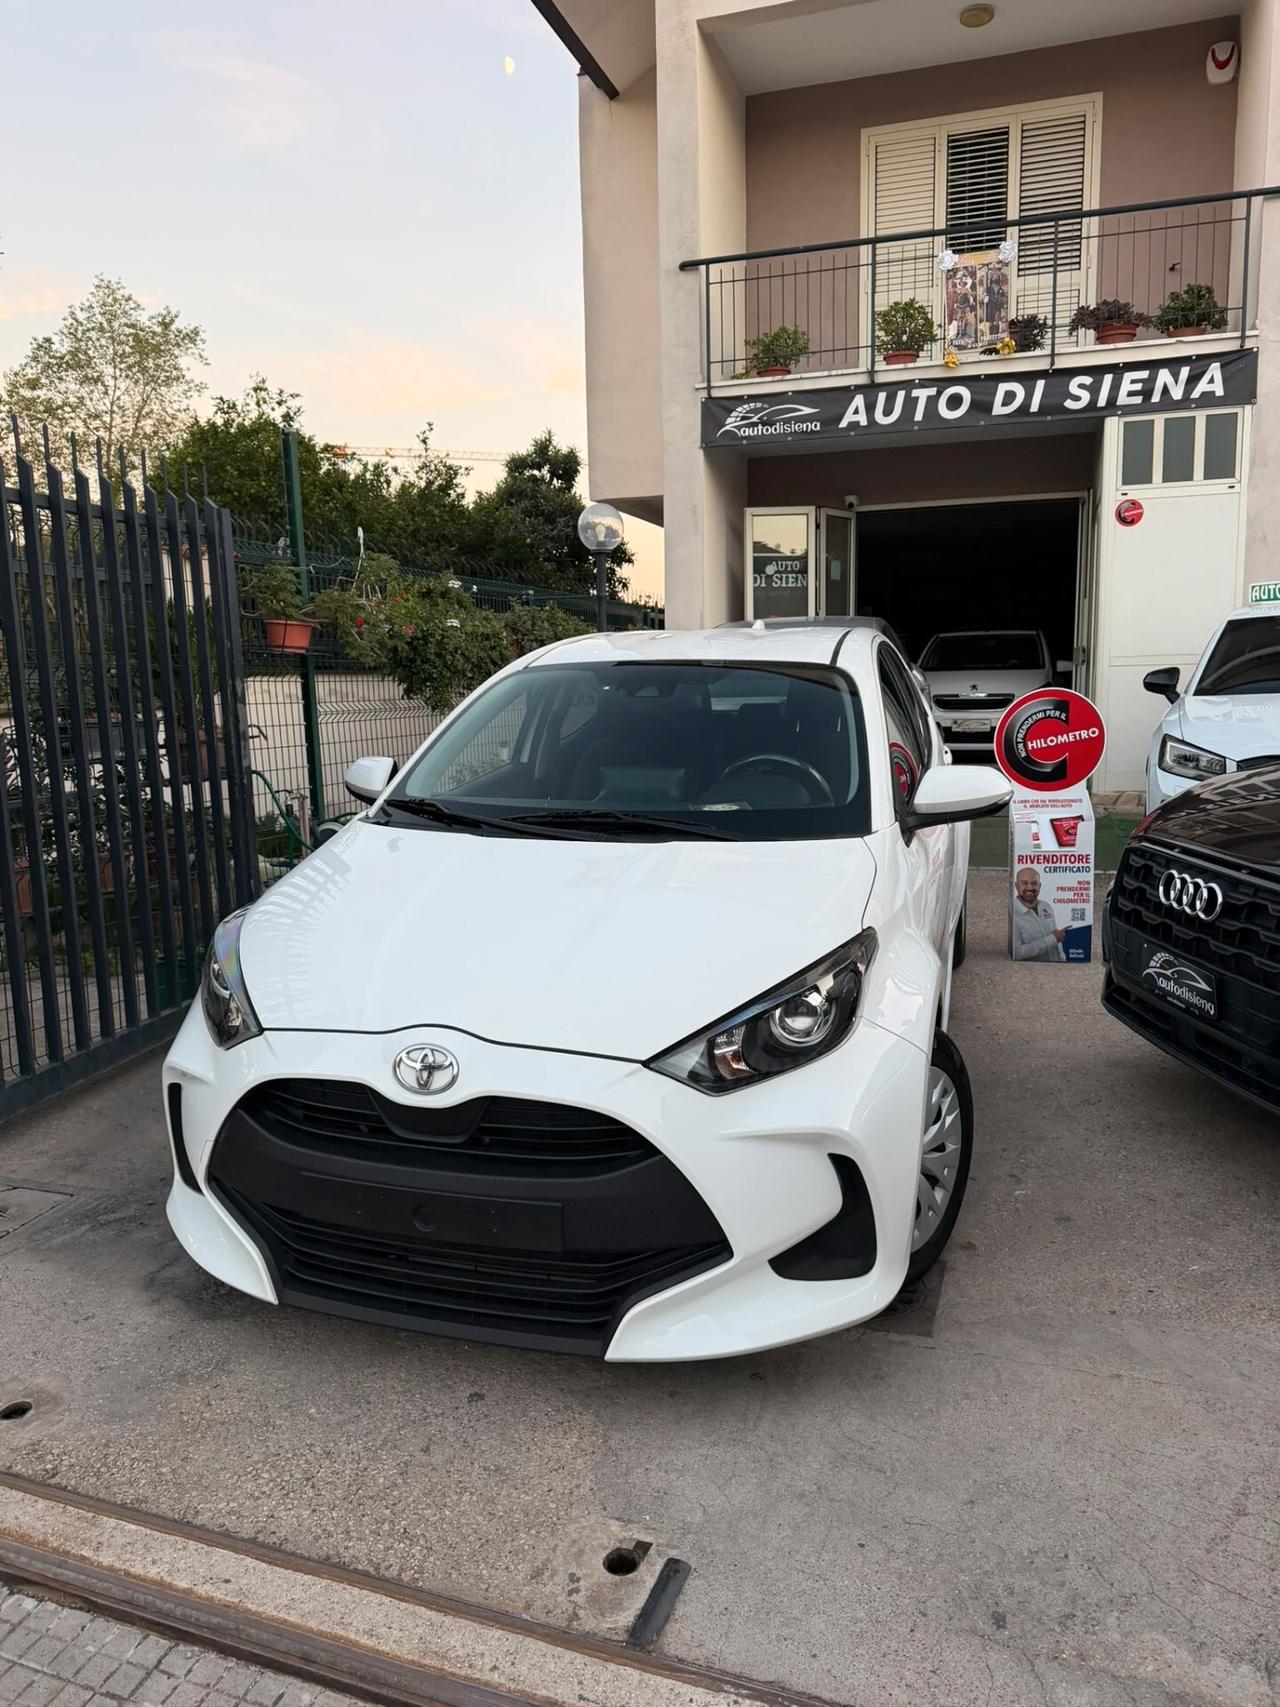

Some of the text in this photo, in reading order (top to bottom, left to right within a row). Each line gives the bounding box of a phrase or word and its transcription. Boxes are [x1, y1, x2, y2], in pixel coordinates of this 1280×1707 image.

[838, 362, 1225, 428] AUTO DI SIENA
[740, 421, 821, 437] autodisiena
[771, 561, 800, 571] AUTO
[1060, 712, 1067, 720] IL
[1017, 711, 1045, 742] PRENDERMI
[1018, 743, 1027, 758] NON
[1017, 854, 1091, 864] RIVENDITORE
[1159, 977, 1215, 1015] autodisiena
